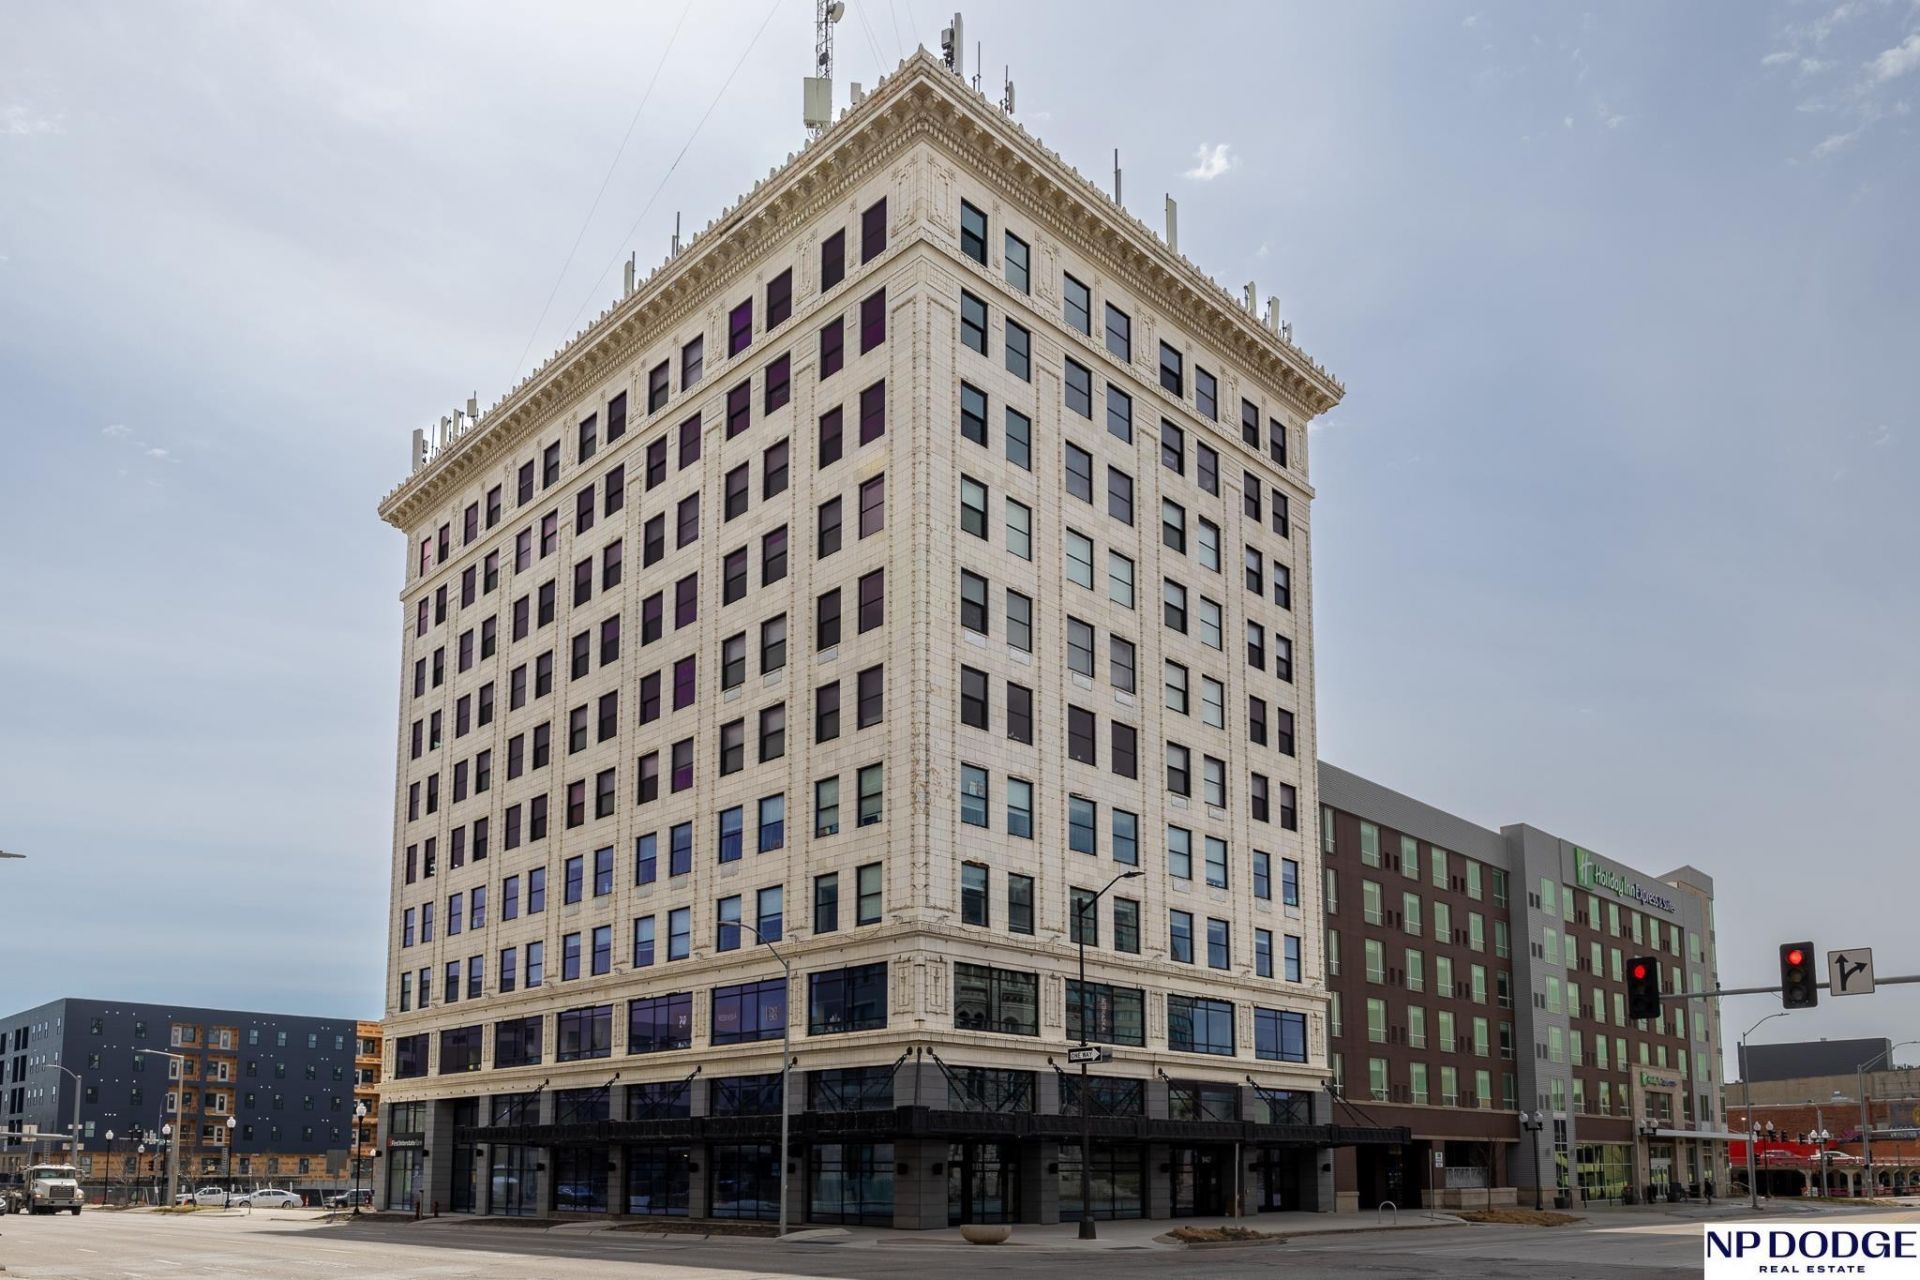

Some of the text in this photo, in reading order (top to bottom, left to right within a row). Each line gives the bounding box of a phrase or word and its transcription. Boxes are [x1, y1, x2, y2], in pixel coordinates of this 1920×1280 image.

[1595, 864, 1624, 897] Holiday
[1624, 876, 1636, 897] Inn
[1071, 1051, 1093, 1060] ONE WAY
